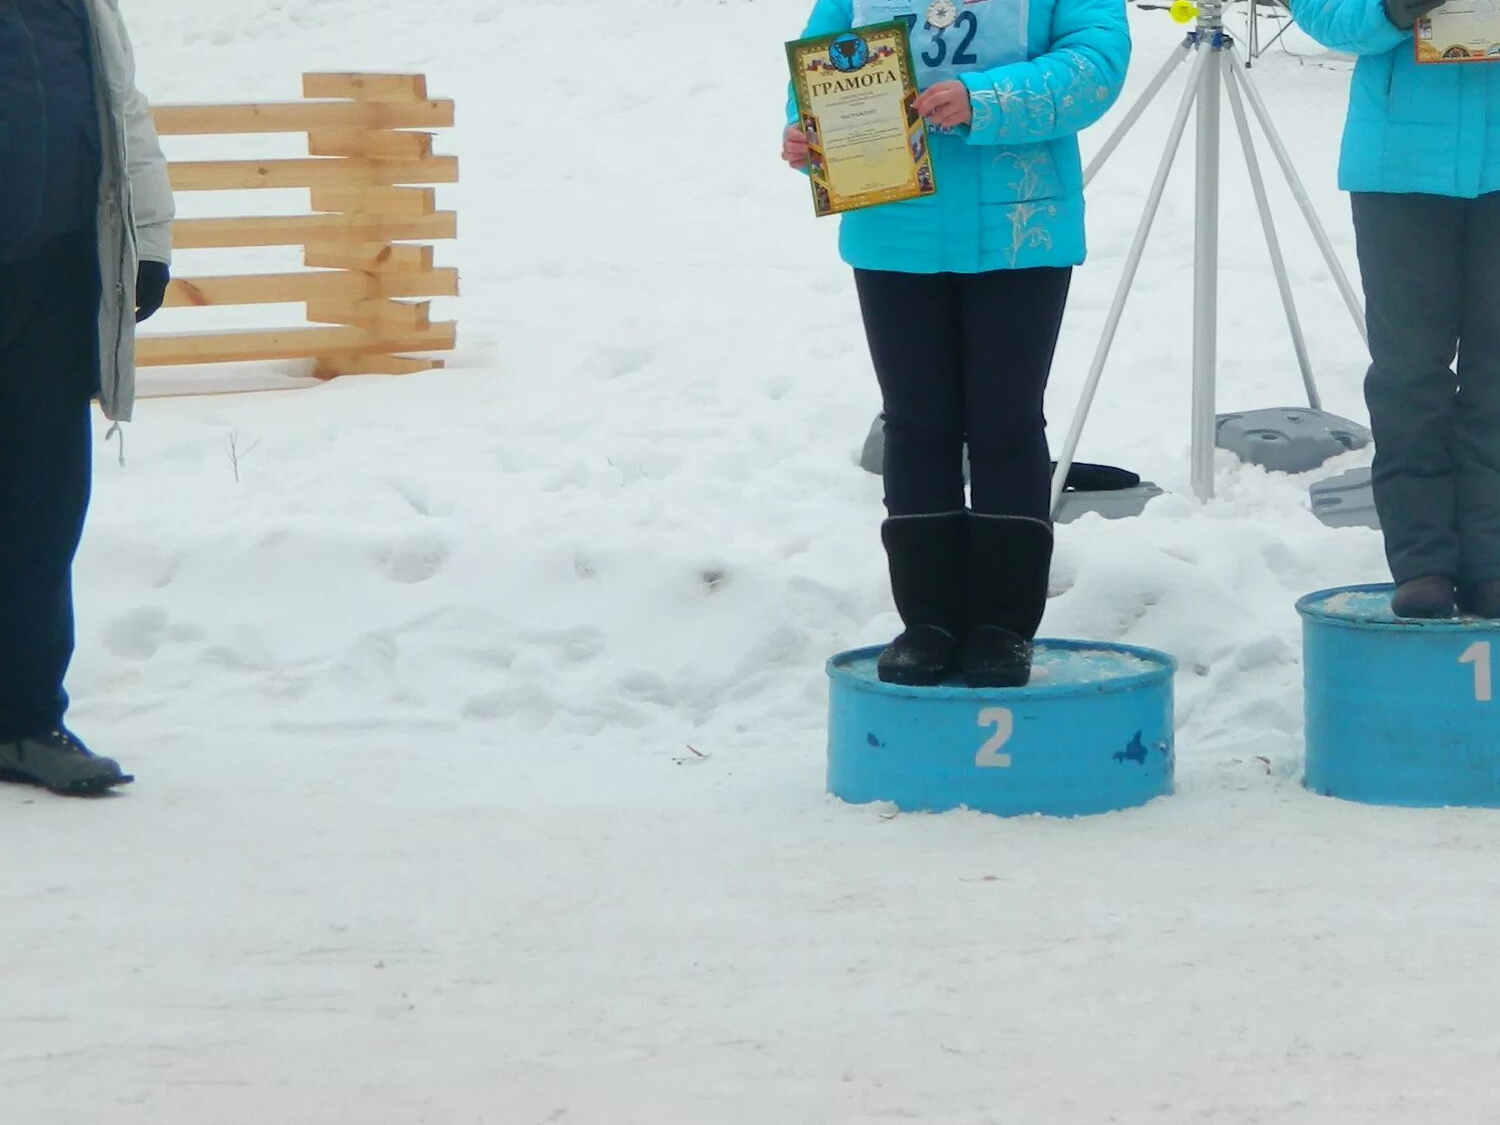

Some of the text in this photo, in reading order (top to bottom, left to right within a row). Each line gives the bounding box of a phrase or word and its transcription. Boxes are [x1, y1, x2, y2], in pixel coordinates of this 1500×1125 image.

[811, 69, 897, 97] ГРАМОТА
[1457, 641, 1491, 701] 1
[976, 707, 1013, 767] 2
